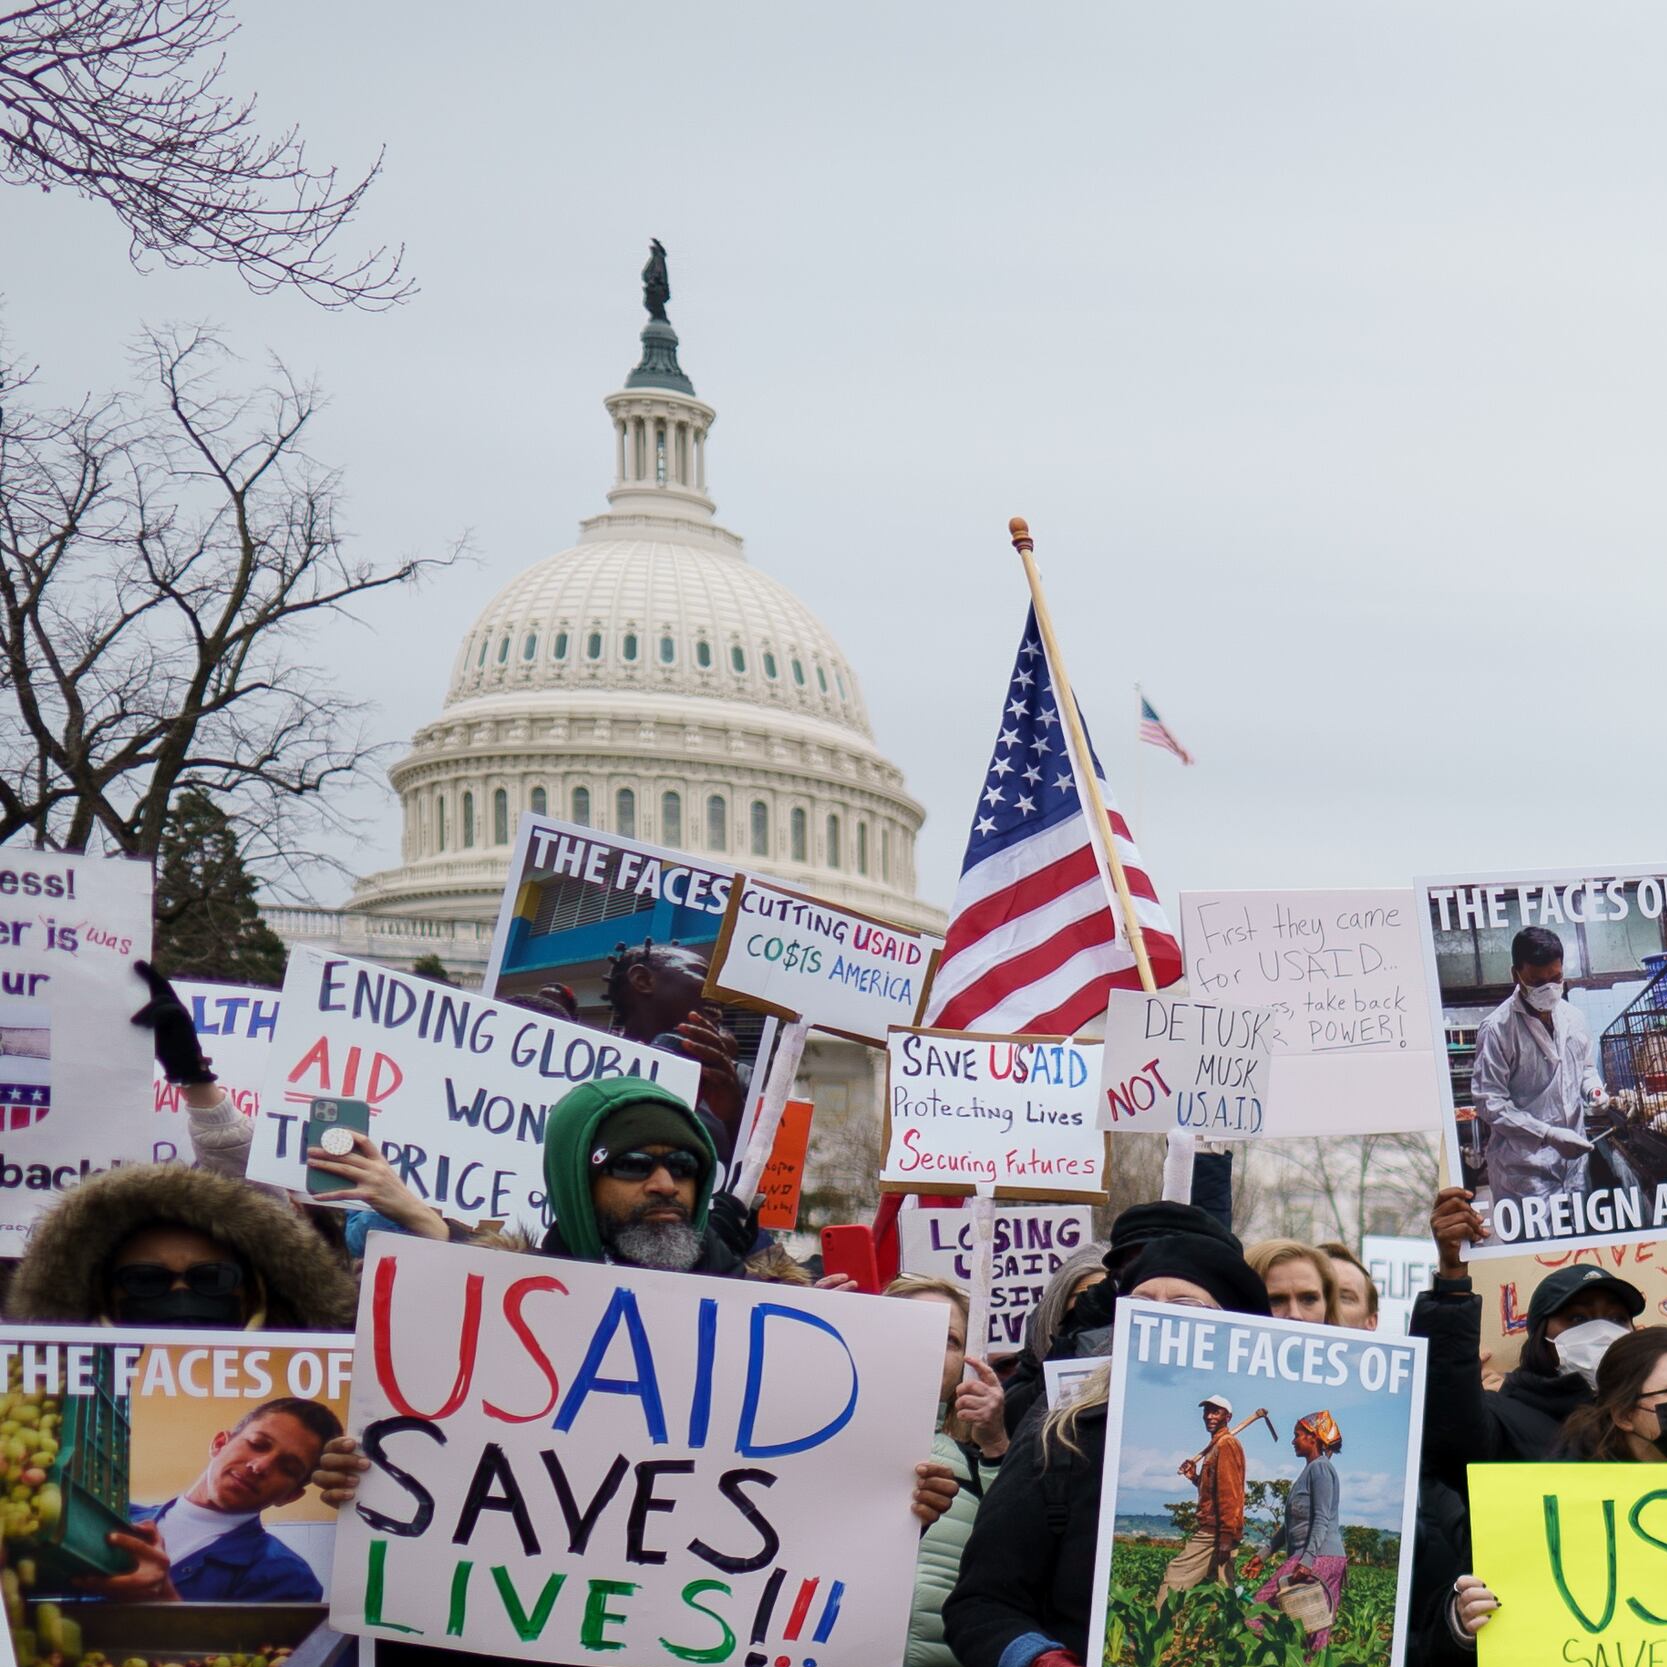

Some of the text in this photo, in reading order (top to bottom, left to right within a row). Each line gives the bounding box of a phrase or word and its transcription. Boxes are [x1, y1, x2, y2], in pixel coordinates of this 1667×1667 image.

[532, 828, 731, 915] THE FACES
[1198, 902, 1401, 953] First they came
[1431, 888, 1509, 931] THE
[1516, 878, 1629, 925] FACES
[86, 926, 132, 955] was
[853, 924, 922, 966] USAID
[1196, 957, 1241, 992] for
[1304, 986, 1346, 1014] take
[1354, 985, 1407, 1013] back
[192, 995, 281, 1043] LTH
[318, 960, 498, 1054] ENDING
[1309, 1014, 1408, 1049] POWER!
[287, 1035, 404, 1105] AID
[902, 1035, 1088, 1089] SAVE USAID
[1106, 1054, 1259, 1122] NOT MUSK
[1027, 1100, 1083, 1126] Lives
[380, 1140, 518, 1218] PRICE
[899, 1128, 1096, 1183] Securing Futures
[0, 1344, 353, 1400] THE FACES OF
[373, 1256, 859, 1459] USAID
[1133, 1315, 1411, 1394] THE FACES OF
[355, 1415, 781, 1575] SAVES
